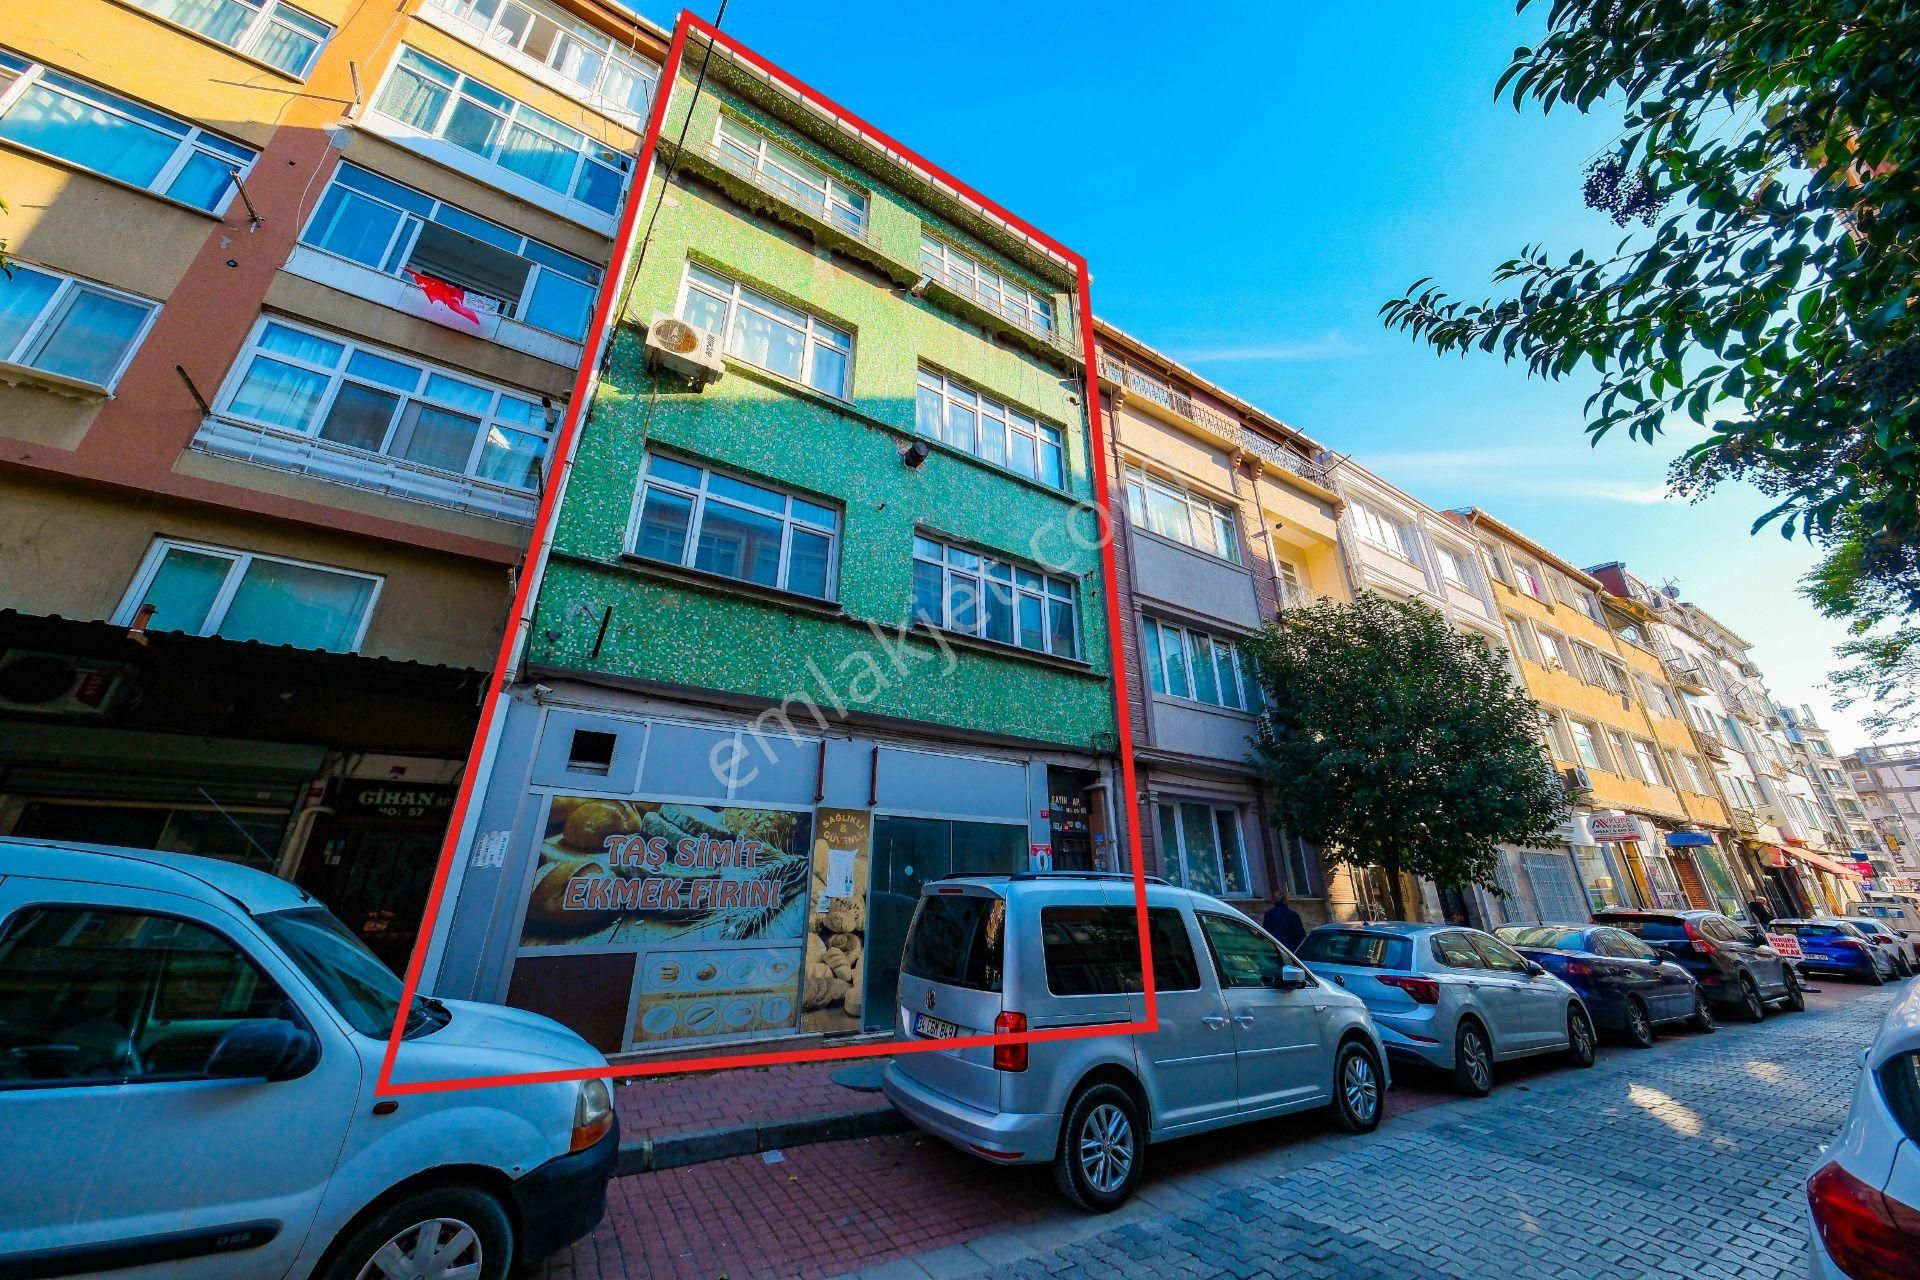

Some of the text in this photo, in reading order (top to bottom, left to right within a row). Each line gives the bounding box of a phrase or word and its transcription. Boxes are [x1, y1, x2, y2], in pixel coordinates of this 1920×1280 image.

[408, 807, 424, 816] 57
[822, 812, 865, 830] SAĞLIKLI
[839, 824, 847, 833] &
[604, 834, 762, 874] TAŞ SİMİT
[563, 877, 783, 911] EKMEK FIRINI
